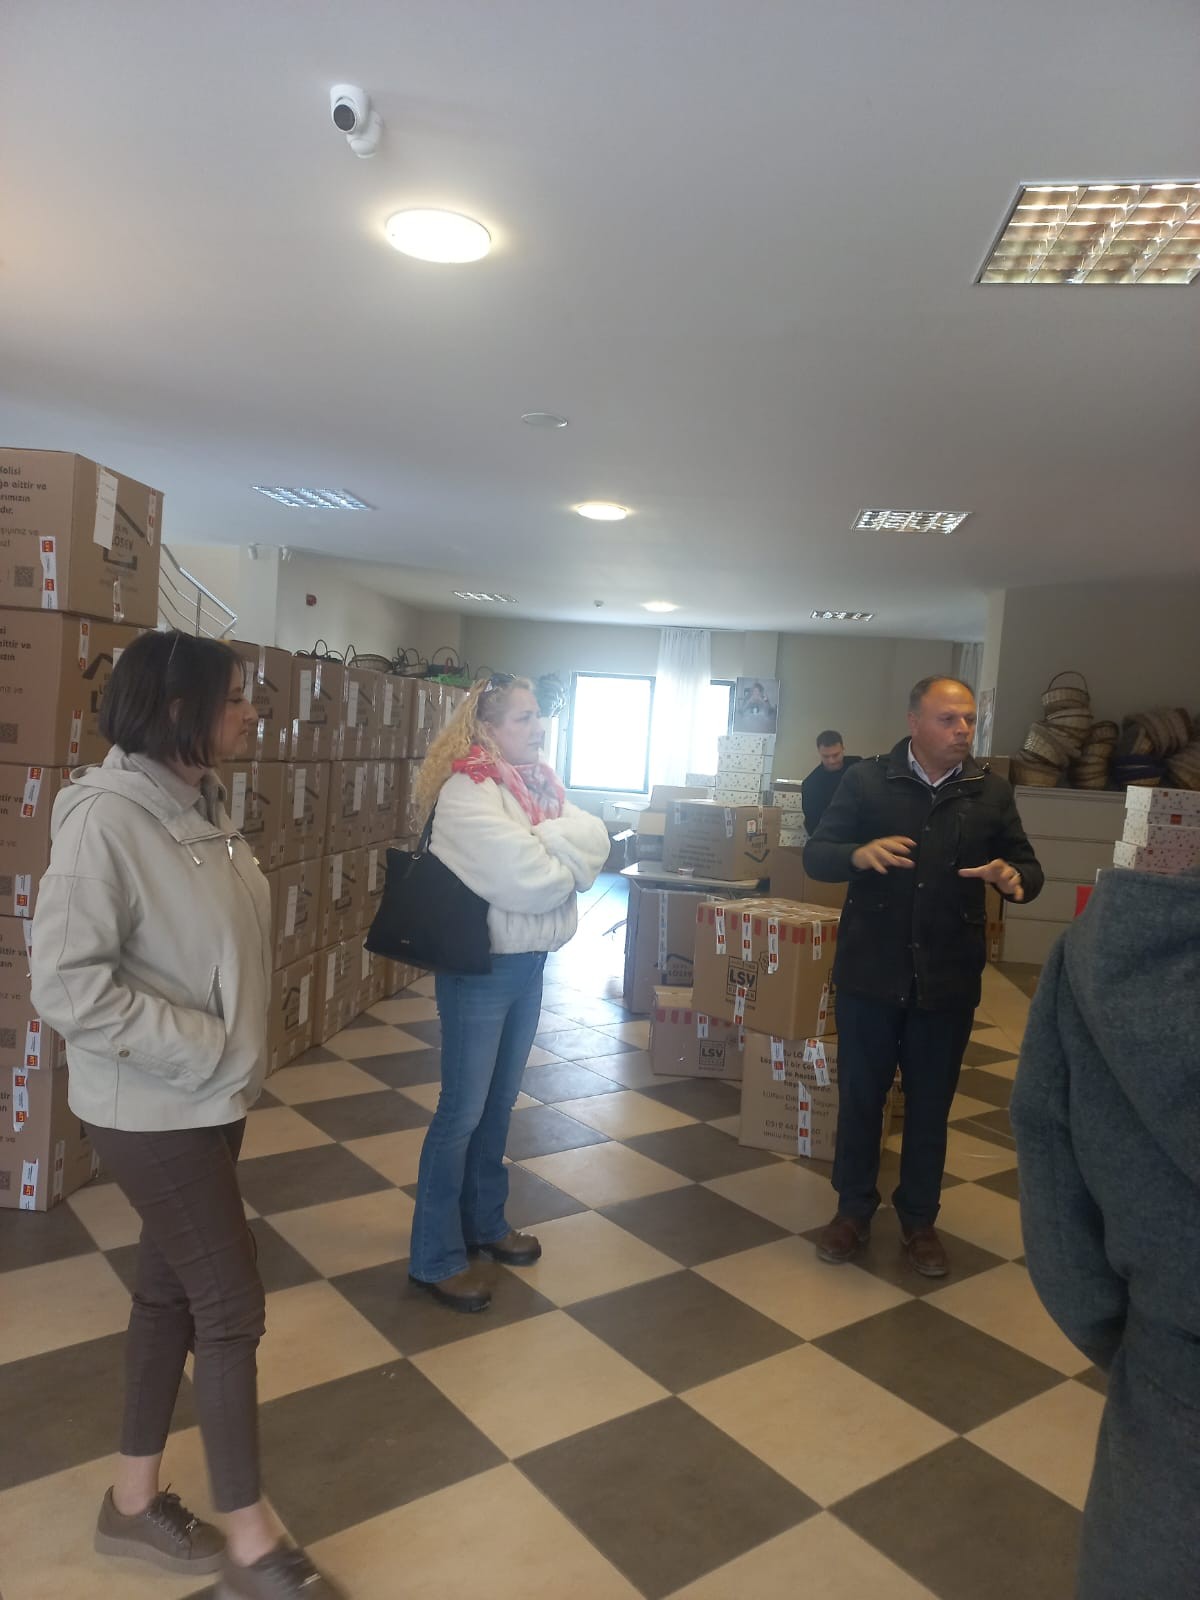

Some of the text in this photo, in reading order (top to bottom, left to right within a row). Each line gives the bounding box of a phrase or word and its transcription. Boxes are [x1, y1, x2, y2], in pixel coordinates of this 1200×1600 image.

[12, 480, 34, 489] aittir
[729, 970, 756, 988] LSV
[702, 1047, 723, 1058] LSV
